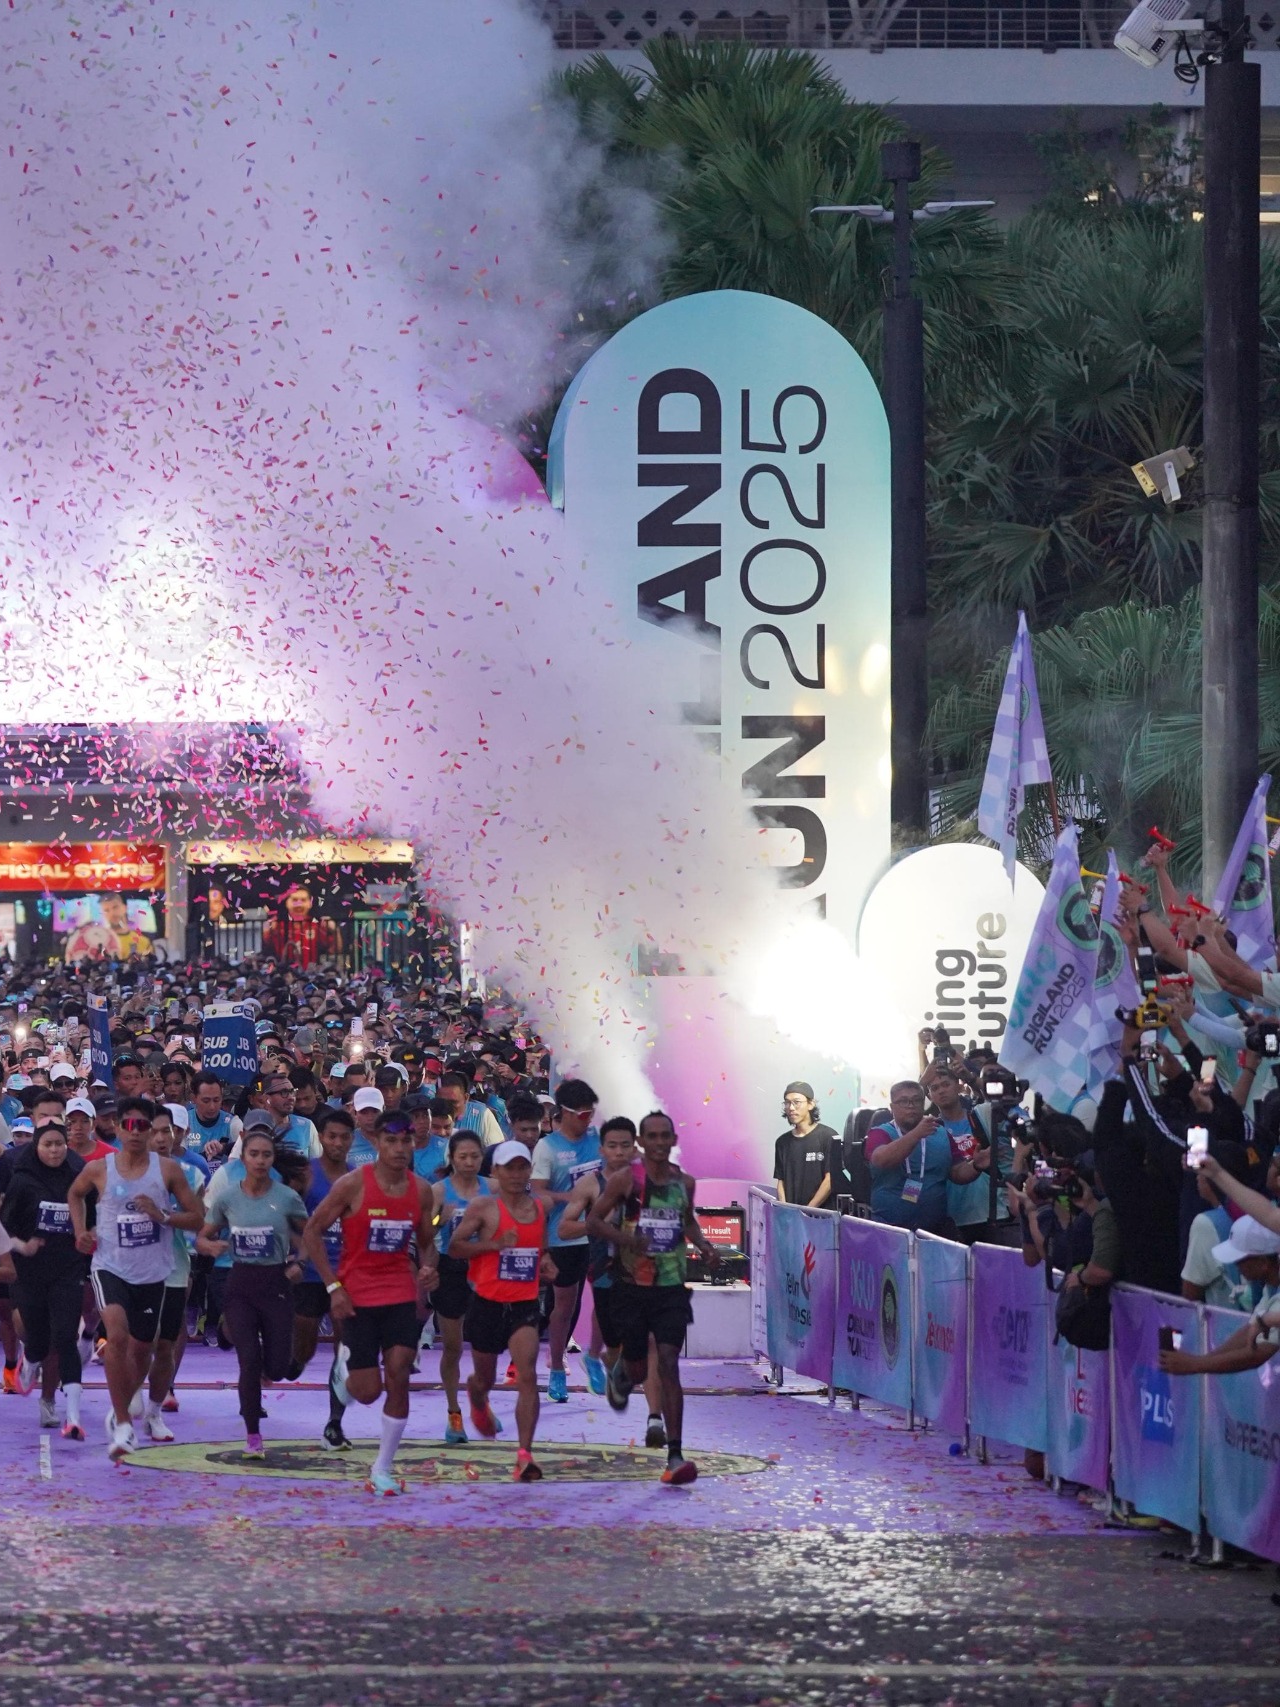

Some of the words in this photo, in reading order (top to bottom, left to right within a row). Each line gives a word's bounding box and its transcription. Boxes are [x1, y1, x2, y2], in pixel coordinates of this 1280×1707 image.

[740, 385, 827, 690] 2025
[741, 715, 827, 920] UN
[74, 862, 155, 878] STORE
[968, 912, 1008, 1050] uture
[1023, 962, 1076, 1046] DIGILAND
[1034, 1016, 1060, 1055] RUN
[1054, 975, 1086, 1020] 2025
[204, 1036, 229, 1050] SUB
